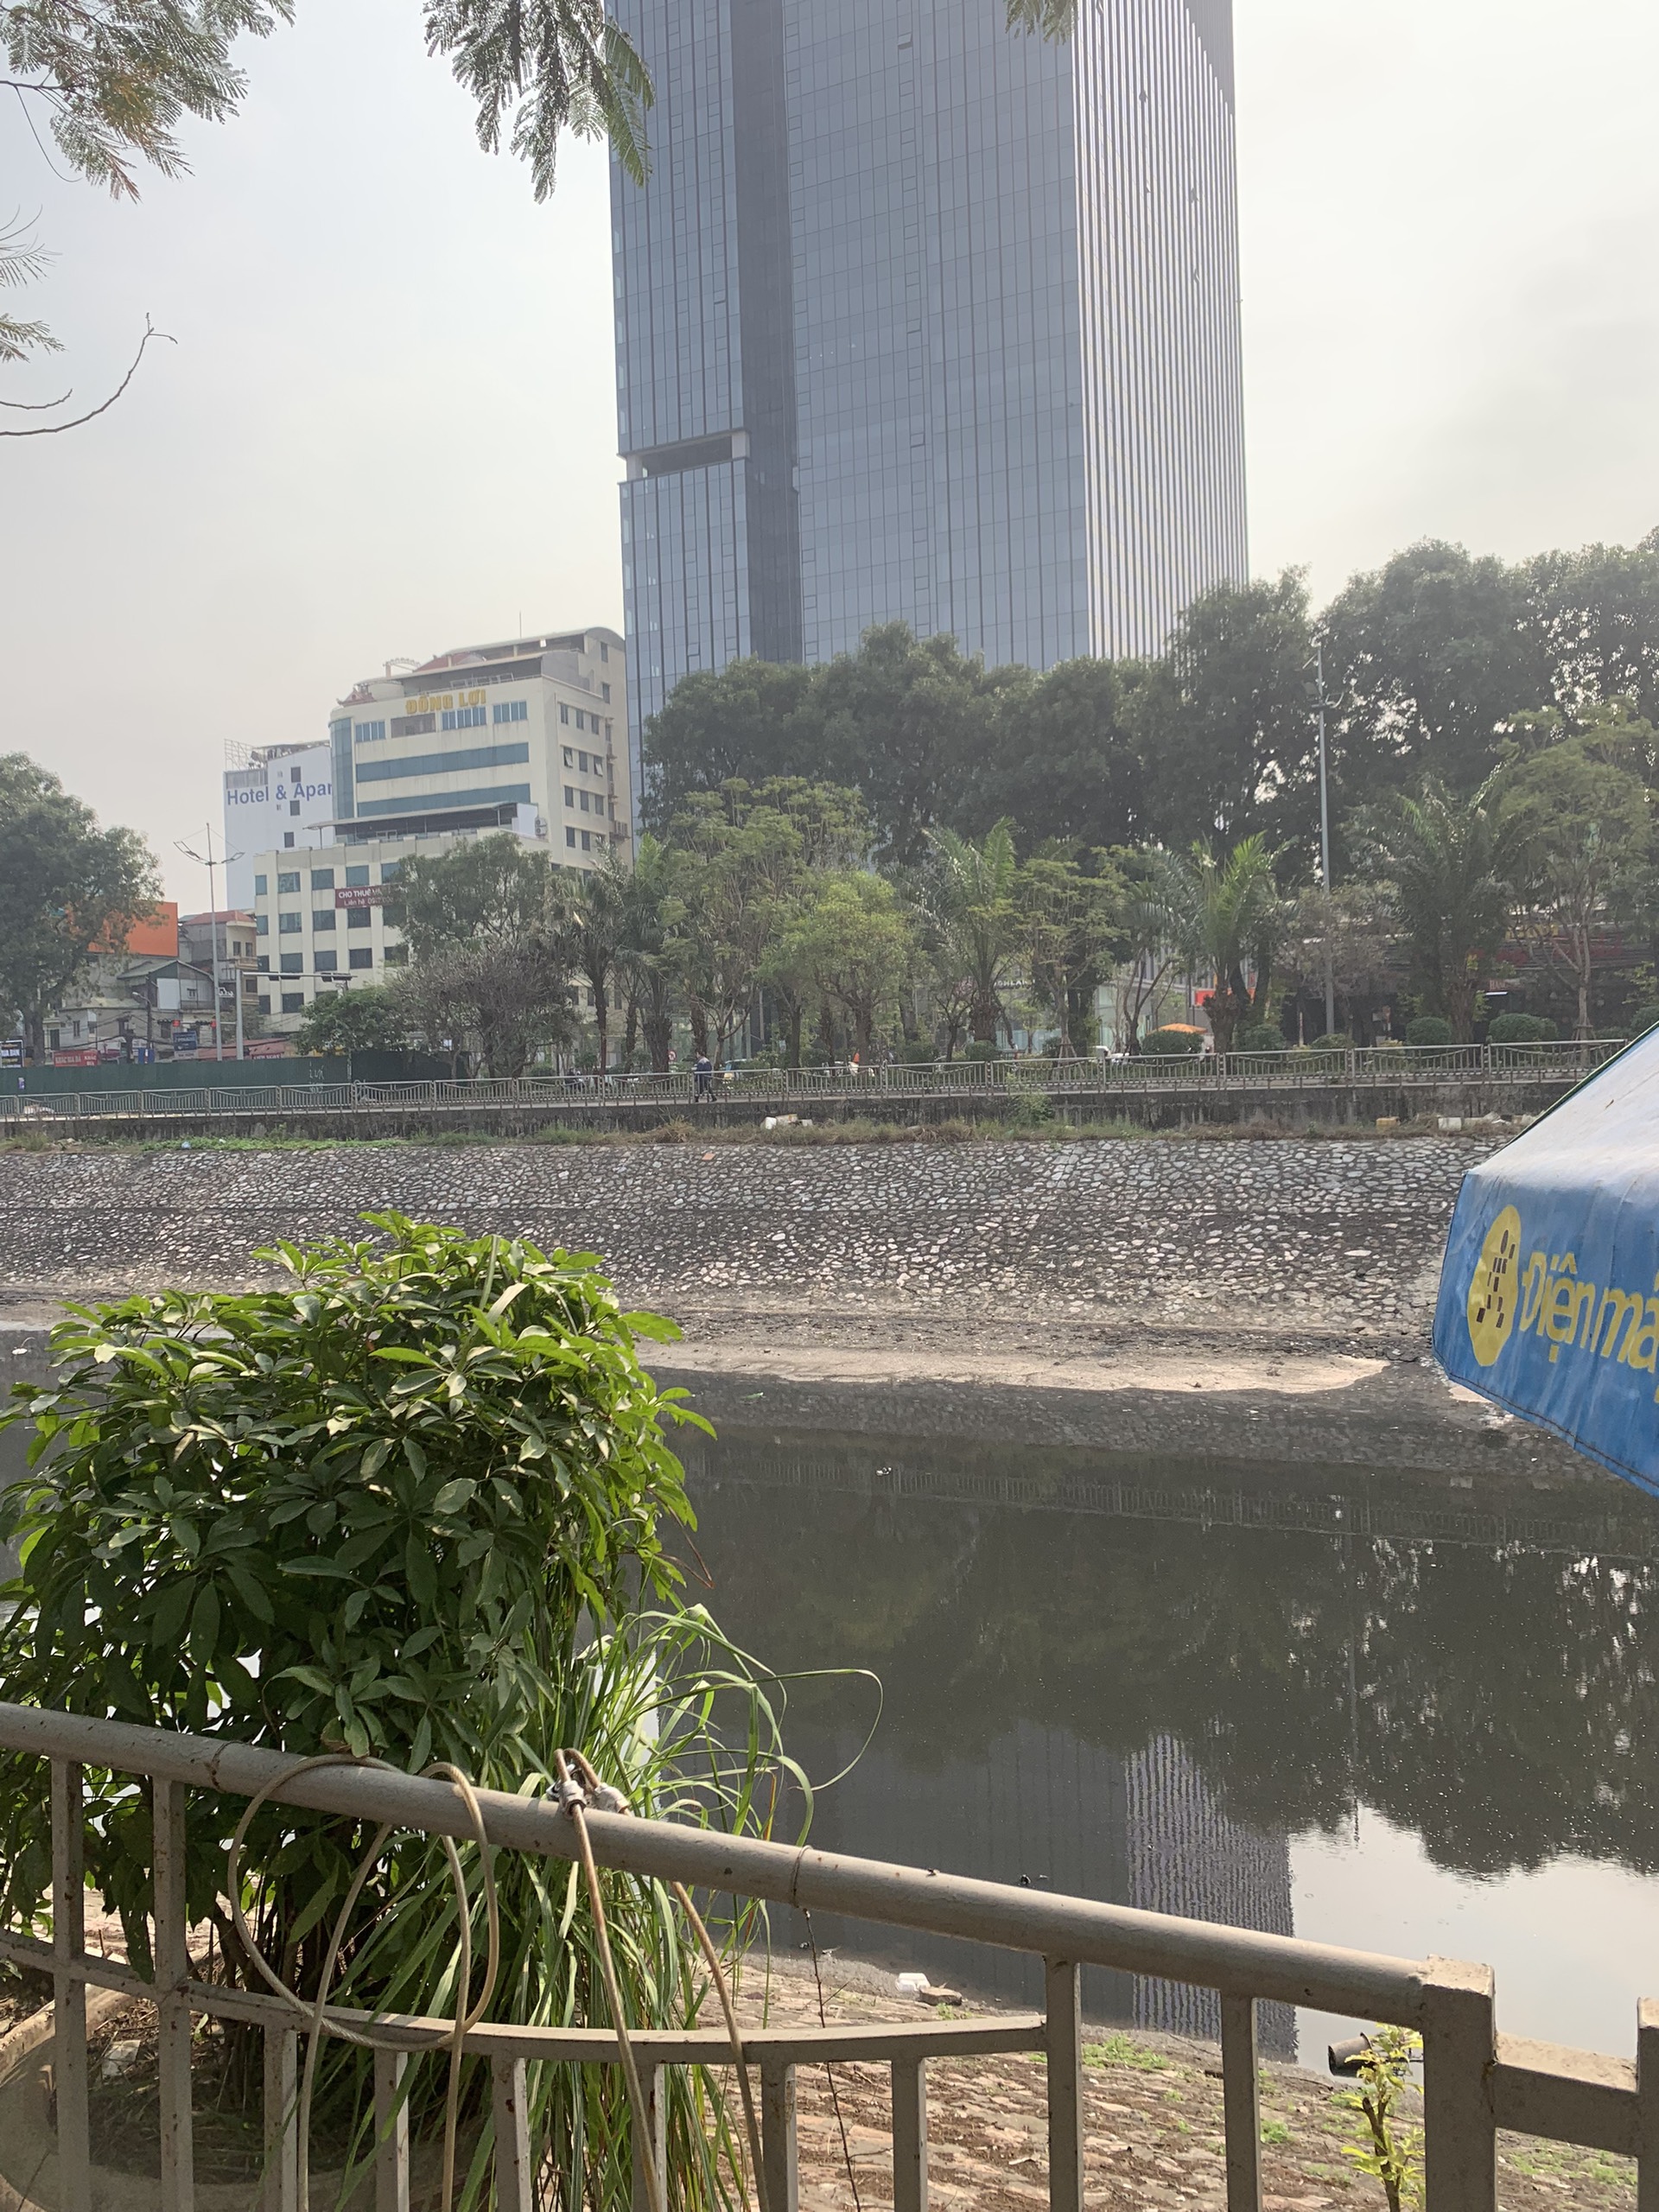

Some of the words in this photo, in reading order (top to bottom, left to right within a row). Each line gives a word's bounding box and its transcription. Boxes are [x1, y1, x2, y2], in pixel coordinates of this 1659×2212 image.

[227, 785, 270, 805] Hotel
[276, 785, 287, 800] &
[1519, 1251, 1596, 1363] Điện
